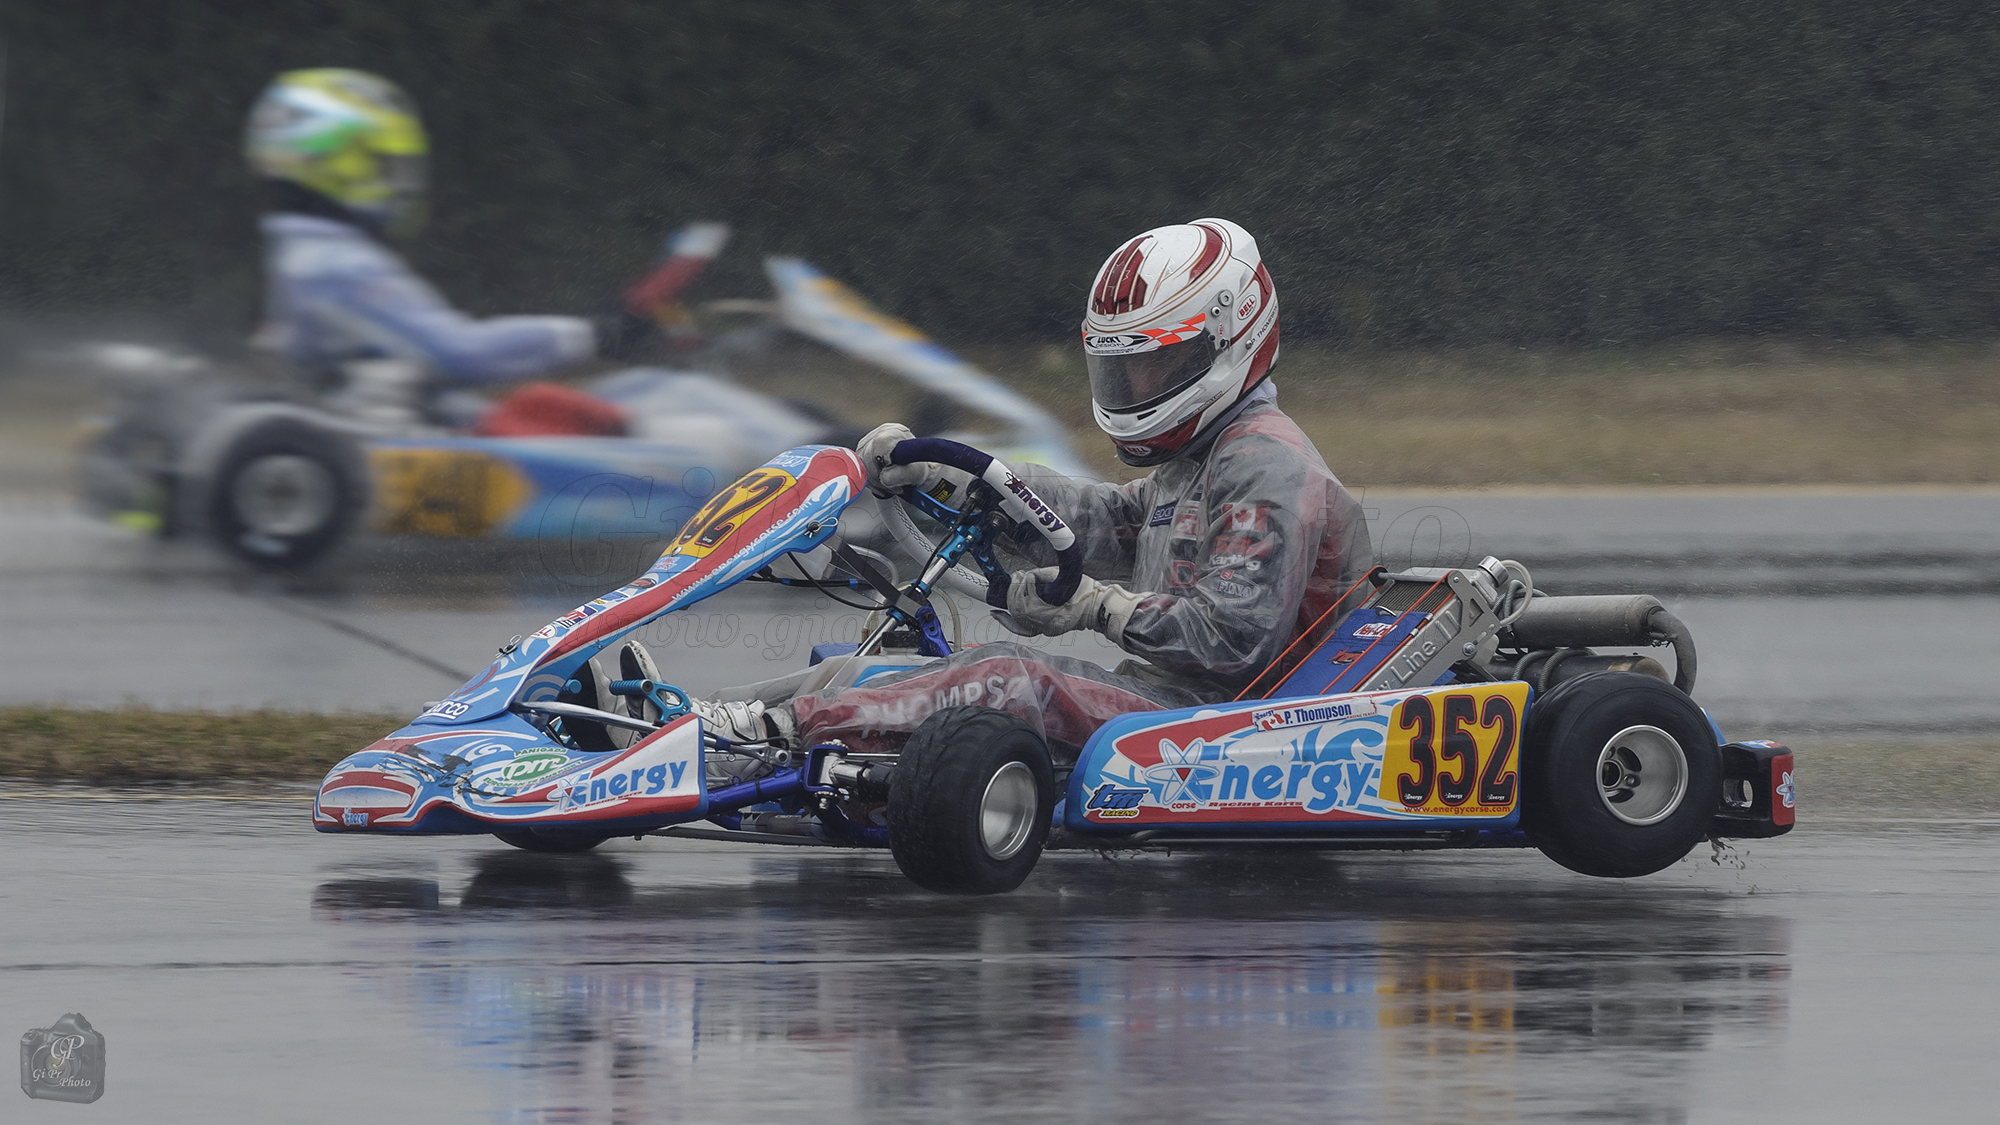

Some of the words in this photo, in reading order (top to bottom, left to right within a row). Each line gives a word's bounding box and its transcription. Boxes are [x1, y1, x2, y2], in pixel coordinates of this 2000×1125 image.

[1239, 298, 1255, 317] BELL
[680, 472, 787, 548] 52
[1012, 480, 1066, 533] Energy
[671, 498, 813, 602] www.energycorse.com
[1208, 554, 1262, 571] Kartig
[1284, 710, 1293, 725] P.
[1294, 704, 1352, 723] Thompson
[515, 747, 567, 756] PANIGADA
[1397, 694, 1517, 807] 352
[483, 776, 525, 788] EUROPEAN
[565, 760, 688, 808] Energy
[1185, 744, 1375, 811] Energy
[1171, 801, 1196, 809] corse
[1208, 800, 1260, 808] Racing
[1264, 799, 1303, 807] Karts
[1404, 806, 1511, 814] www.energycorse.com
